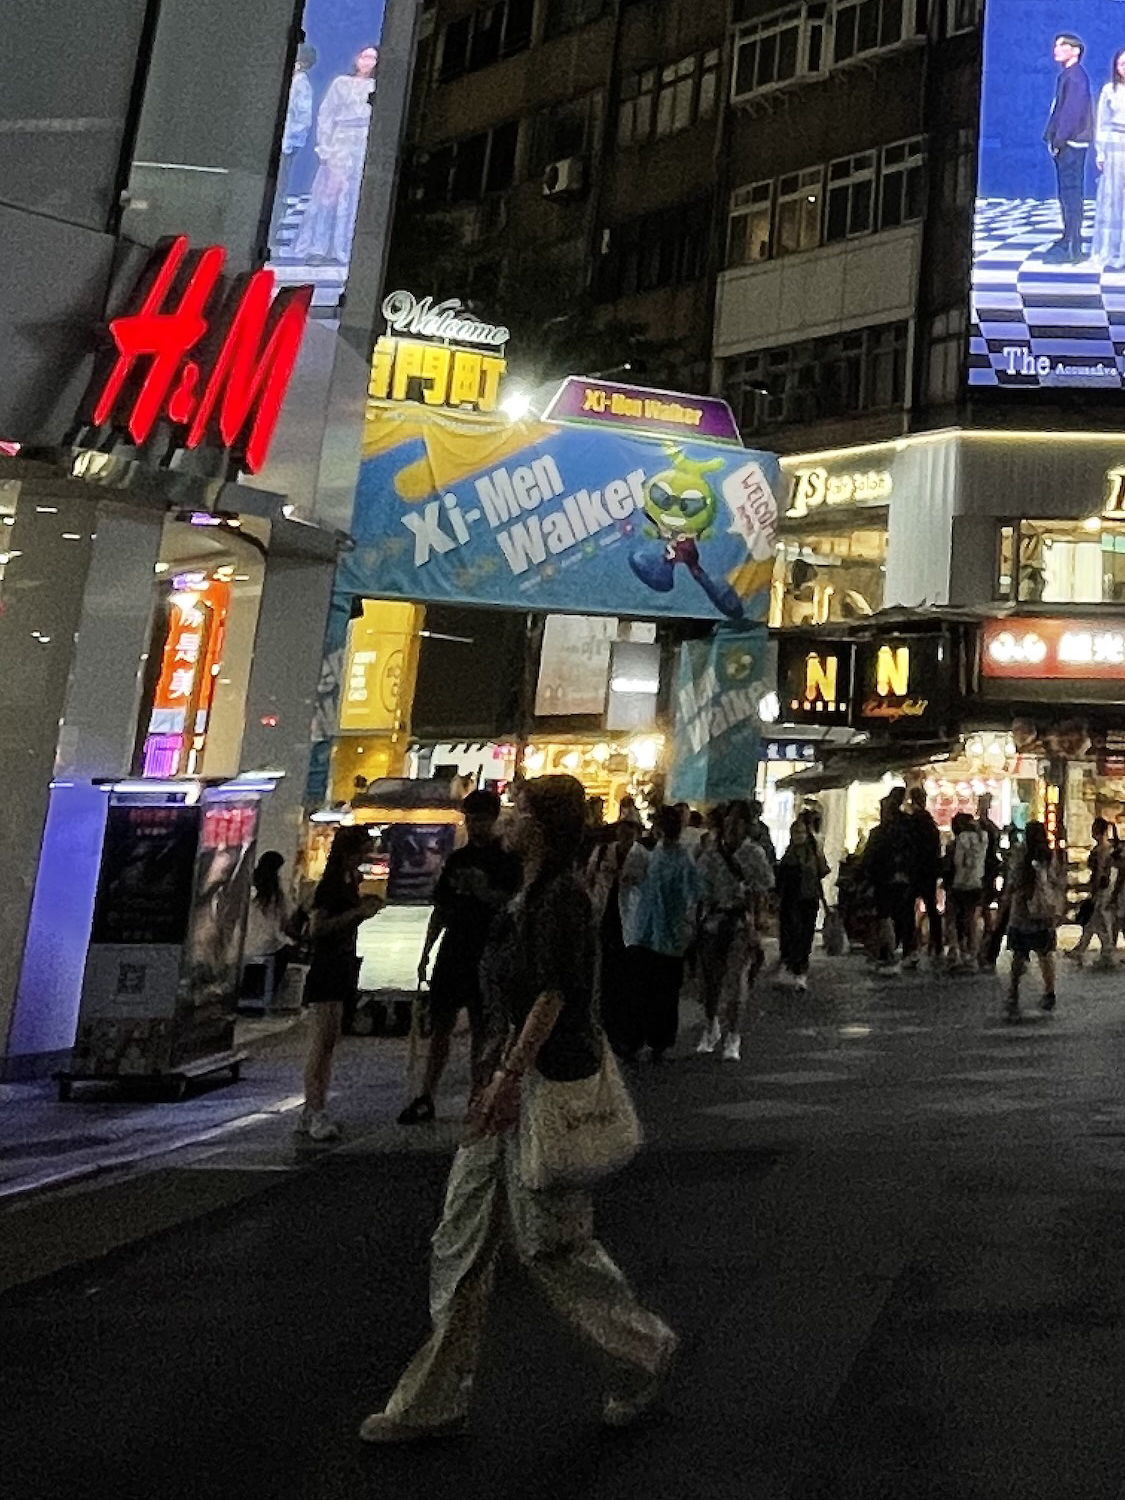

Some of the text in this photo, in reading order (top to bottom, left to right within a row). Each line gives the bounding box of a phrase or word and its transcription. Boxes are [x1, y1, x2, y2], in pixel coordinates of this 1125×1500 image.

[93, 233, 315, 474] H&M
[382, 290, 510, 346] Welcome
[1003, 346, 1051, 376] The
[583, 388, 704, 426] Xi-Men Walker
[400, 454, 565, 568] Xi-Men
[496, 468, 647, 575] Walker
